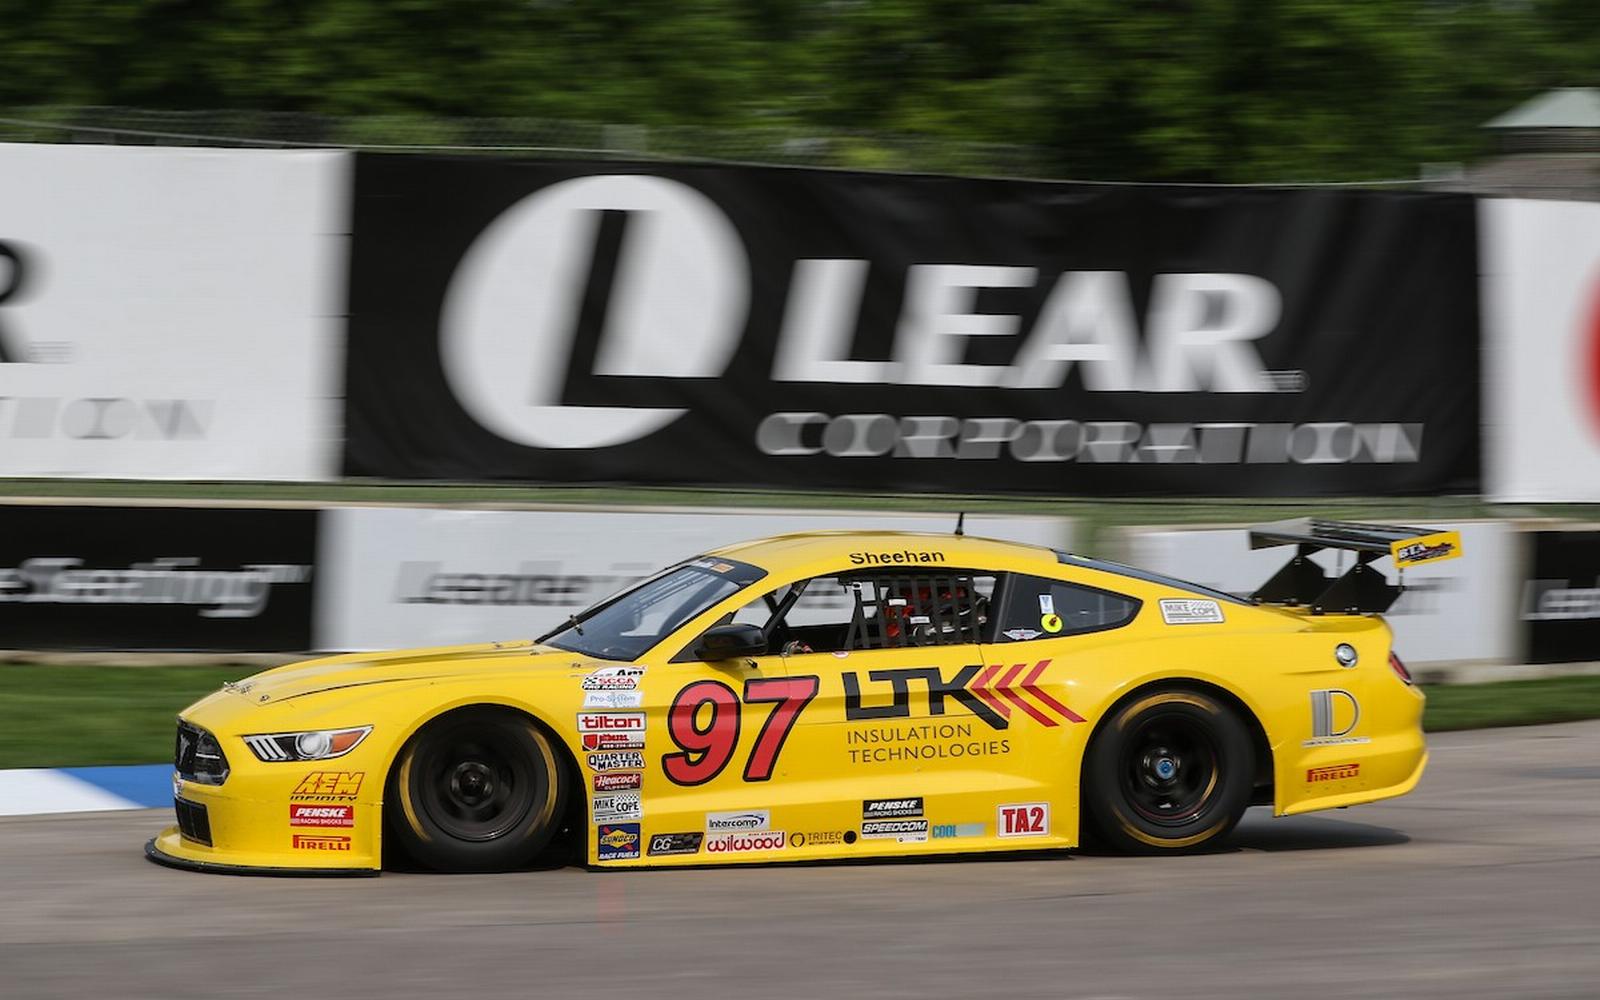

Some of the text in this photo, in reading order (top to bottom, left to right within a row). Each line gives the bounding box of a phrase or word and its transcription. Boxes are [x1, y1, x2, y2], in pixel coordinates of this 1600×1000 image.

[772, 257, 1284, 393] LEAR
[757, 411, 1424, 464] CORPORATION
[850, 550, 945, 566] Sheehan
[1165, 604, 1217, 616] MIKE COPE
[599, 677, 635, 685] SCCA
[841, 664, 1009, 731] LTK
[582, 716, 641, 729] tilton
[662, 674, 820, 787] 97
[847, 723, 972, 745] INSULATION
[848, 739, 1011, 764] TECHNOLOGIES
[588, 752, 639, 766] QUARTER
[598, 760, 643, 771] MASTER
[1307, 764, 1360, 782] PIRELLI
[292, 772, 365, 795] AEM
[595, 774, 640, 787] Heacock
[594, 799, 639, 812] MIKE COPE
[869, 800, 917, 811] PENSKE
[295, 807, 347, 818] PENSKE
[709, 819, 758, 828] Intercomp
[1002, 806, 1045, 834] TA2
[808, 831, 842, 841] TRITEC
[932, 825, 957, 838] COOL
[293, 835, 351, 850] PIRELLI
[602, 834, 638, 844] SUNOCO
[652, 838, 671, 850] CG
[707, 832, 785, 852] wilwood
